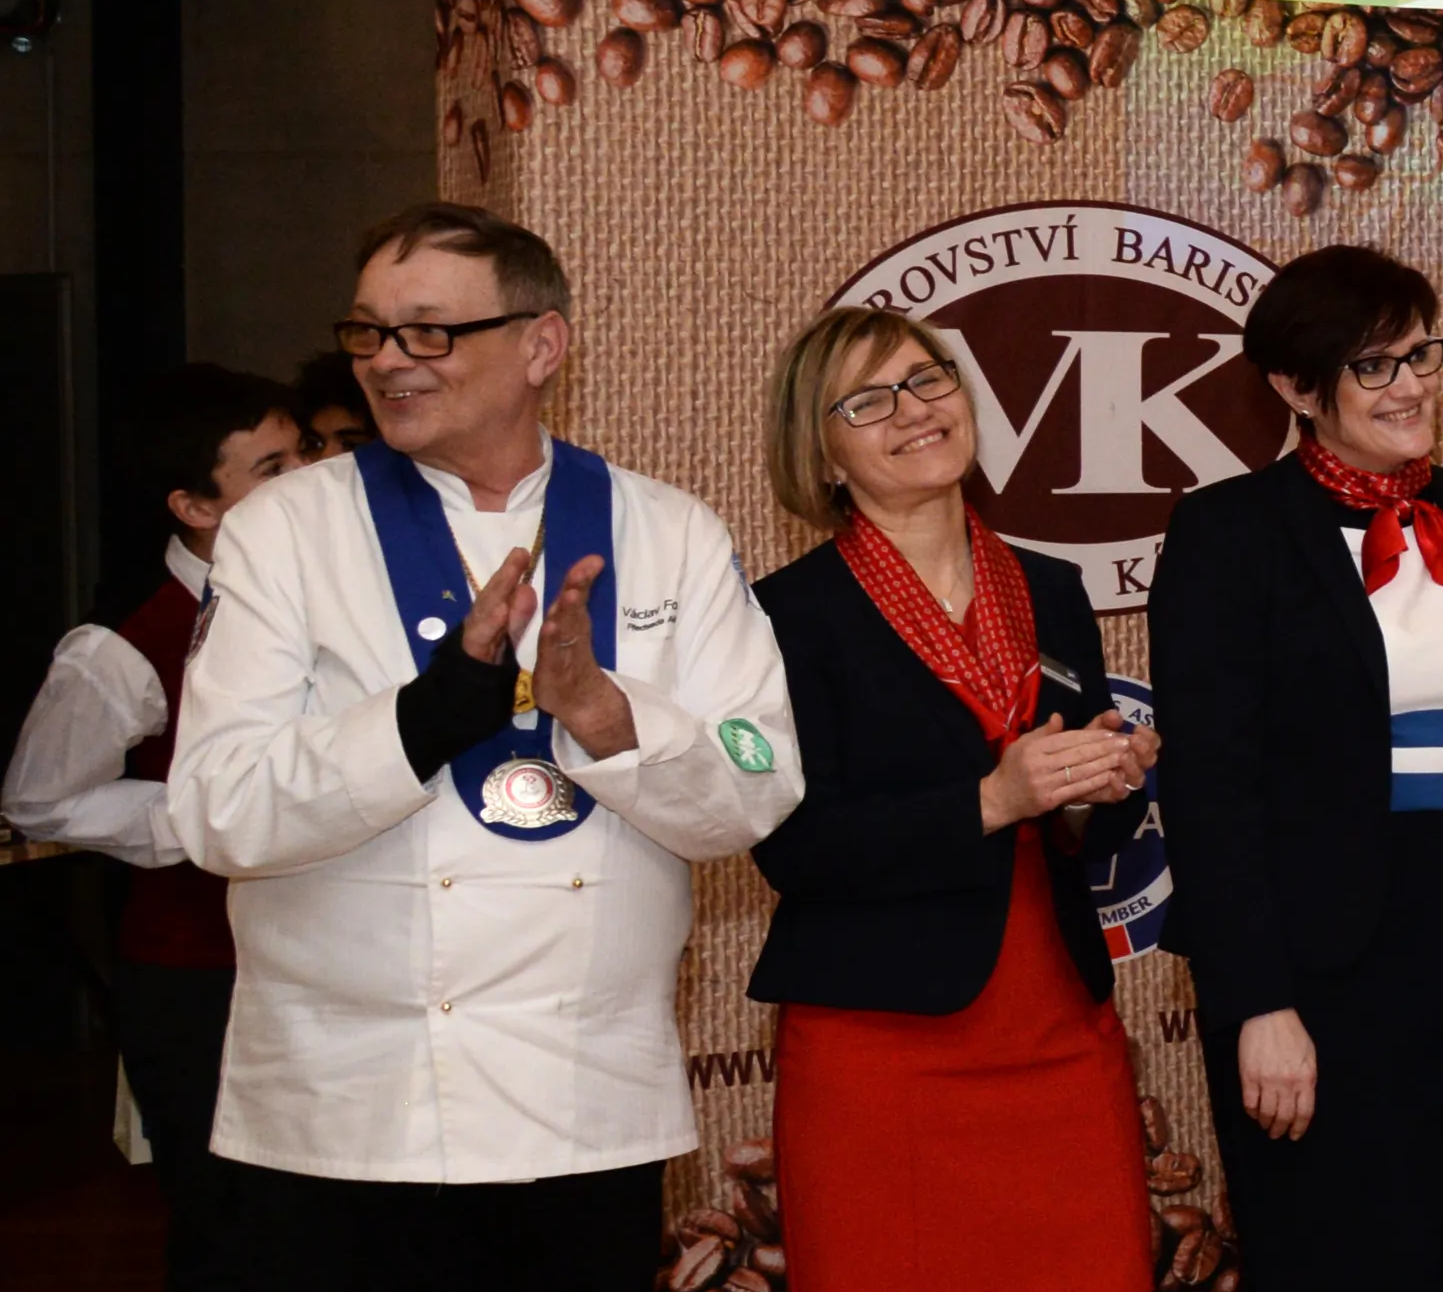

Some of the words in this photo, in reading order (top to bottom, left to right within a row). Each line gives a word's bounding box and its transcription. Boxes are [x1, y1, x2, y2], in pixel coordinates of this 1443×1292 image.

[864, 213, 1080, 313] ROVSTVÍ
[1111, 226, 1262, 307] BARIS
[1100, 895, 1153, 926] MBER
